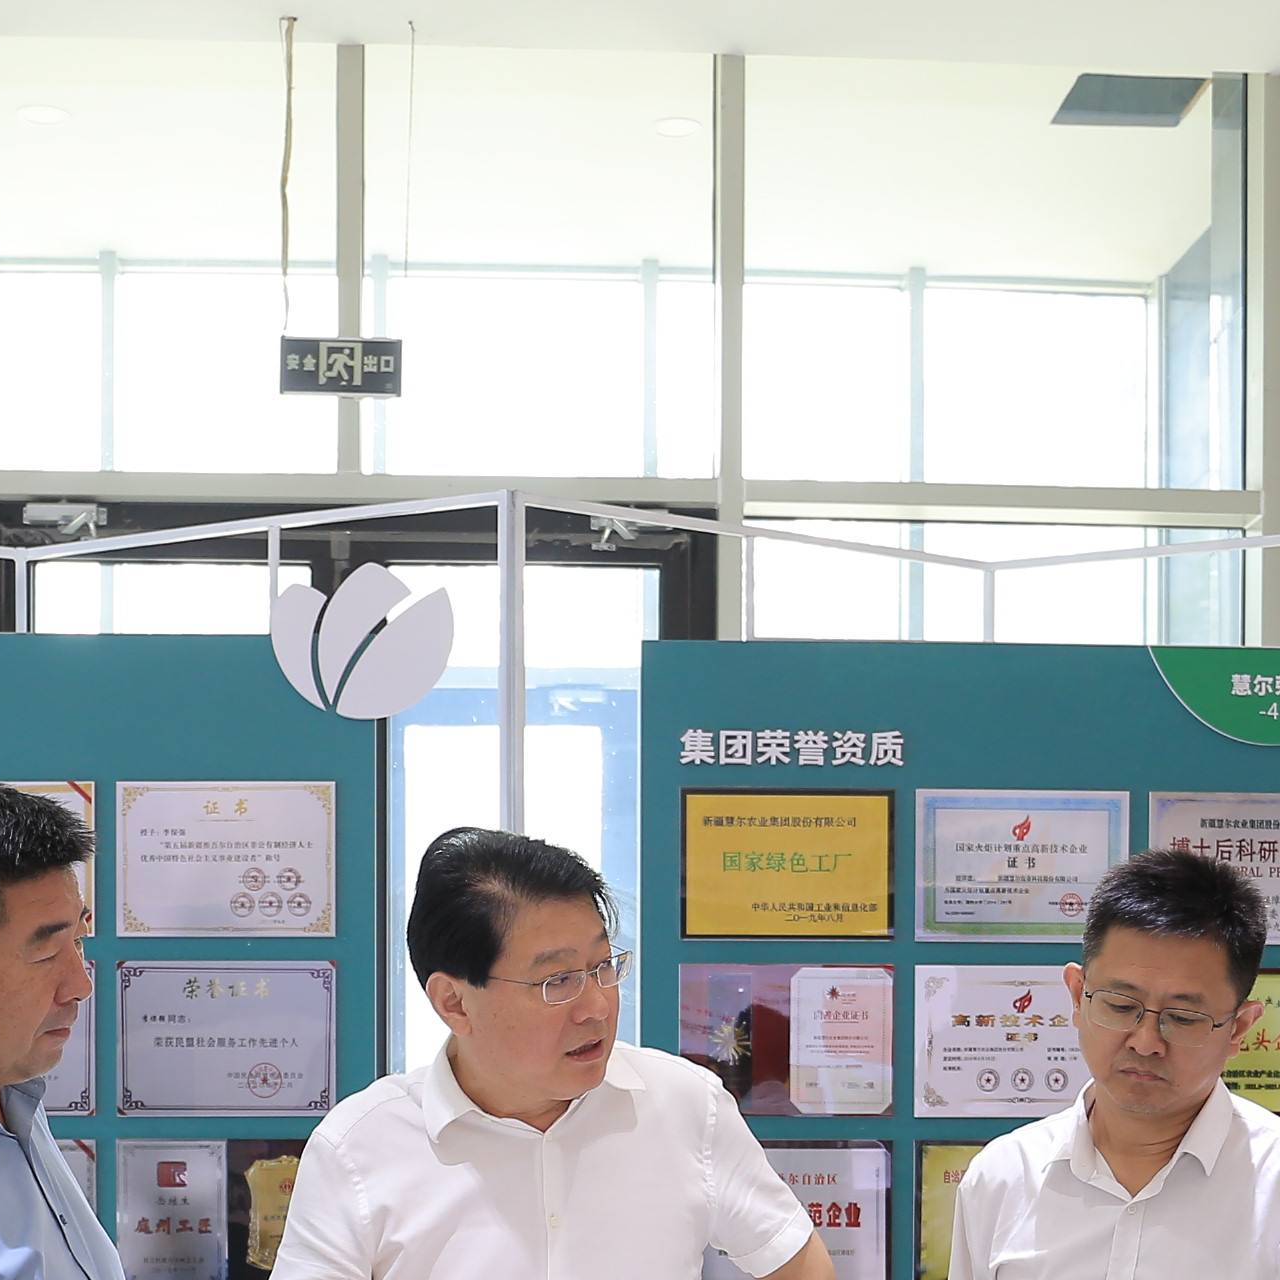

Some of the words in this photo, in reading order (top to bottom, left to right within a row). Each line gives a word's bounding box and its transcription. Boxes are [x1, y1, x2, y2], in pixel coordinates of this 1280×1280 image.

[286, 353, 317, 372] 安全
[363, 354, 395, 373] 出口
[679, 728, 905, 767] 集团荣誉资质
[204, 798, 249, 816] 证书
[703, 815, 857, 829] 新疆慧尔农业集团股份有限公司
[955, 842, 1088, 855] 国家火炬计划重点高新技术企业
[722, 851, 852, 874] 国家绿色工厂
[1007, 856, 1037, 869] 证书
[751, 902, 878, 913] 中华人民共和国工业和信息化部
[182, 976, 272, 1000] 荣誉证书
[951, 1014, 1069, 1028] 高新技术企
[153, 1036, 299, 1049] 荣获民盟社会服务工作先进个人
